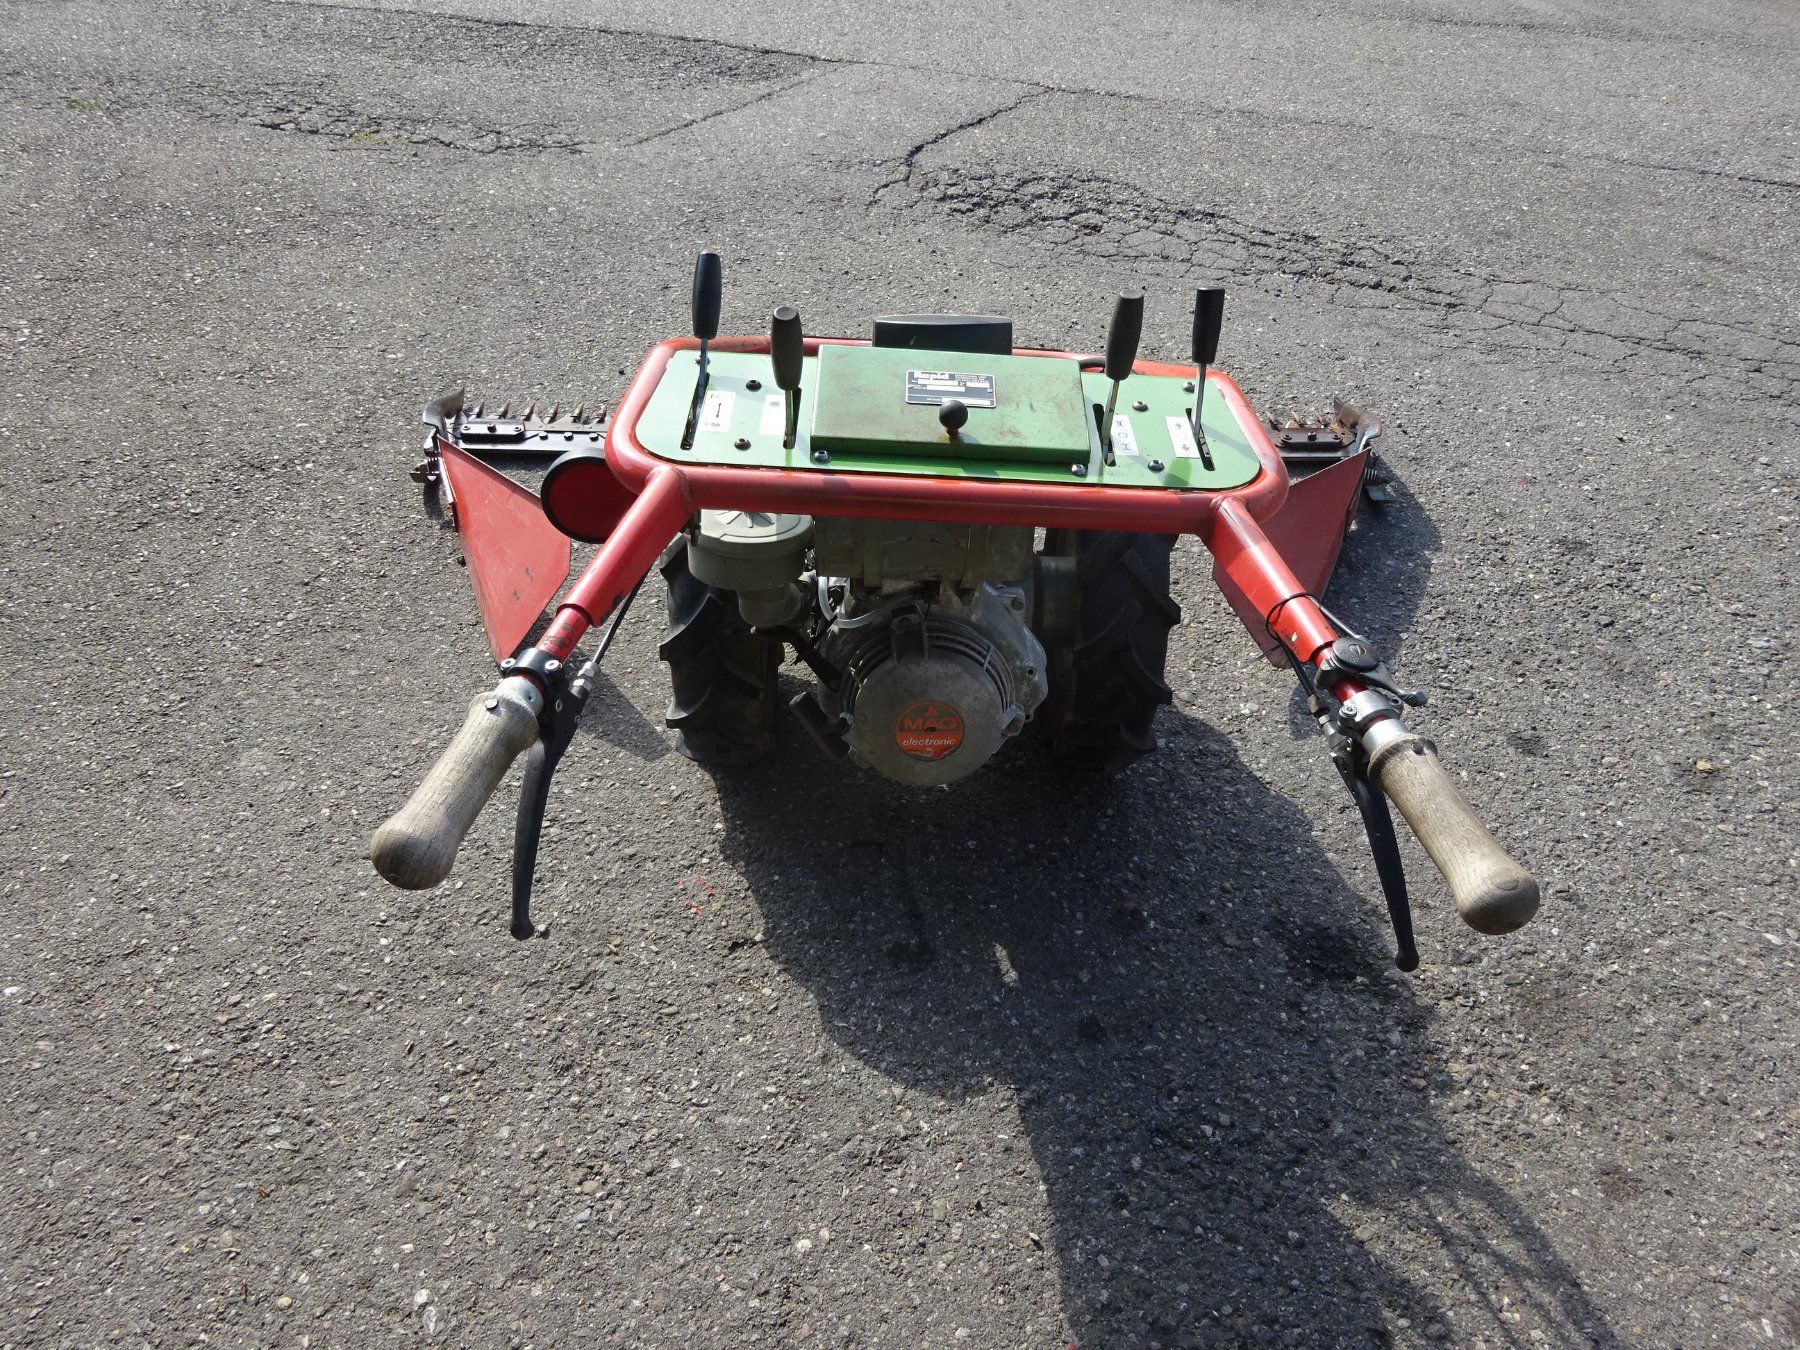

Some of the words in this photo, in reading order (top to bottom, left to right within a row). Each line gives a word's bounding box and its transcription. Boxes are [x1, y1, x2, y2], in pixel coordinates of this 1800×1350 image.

[913, 371, 948, 380] Rapid
[903, 717, 957, 730] MAG
[903, 737, 956, 746] electronic
